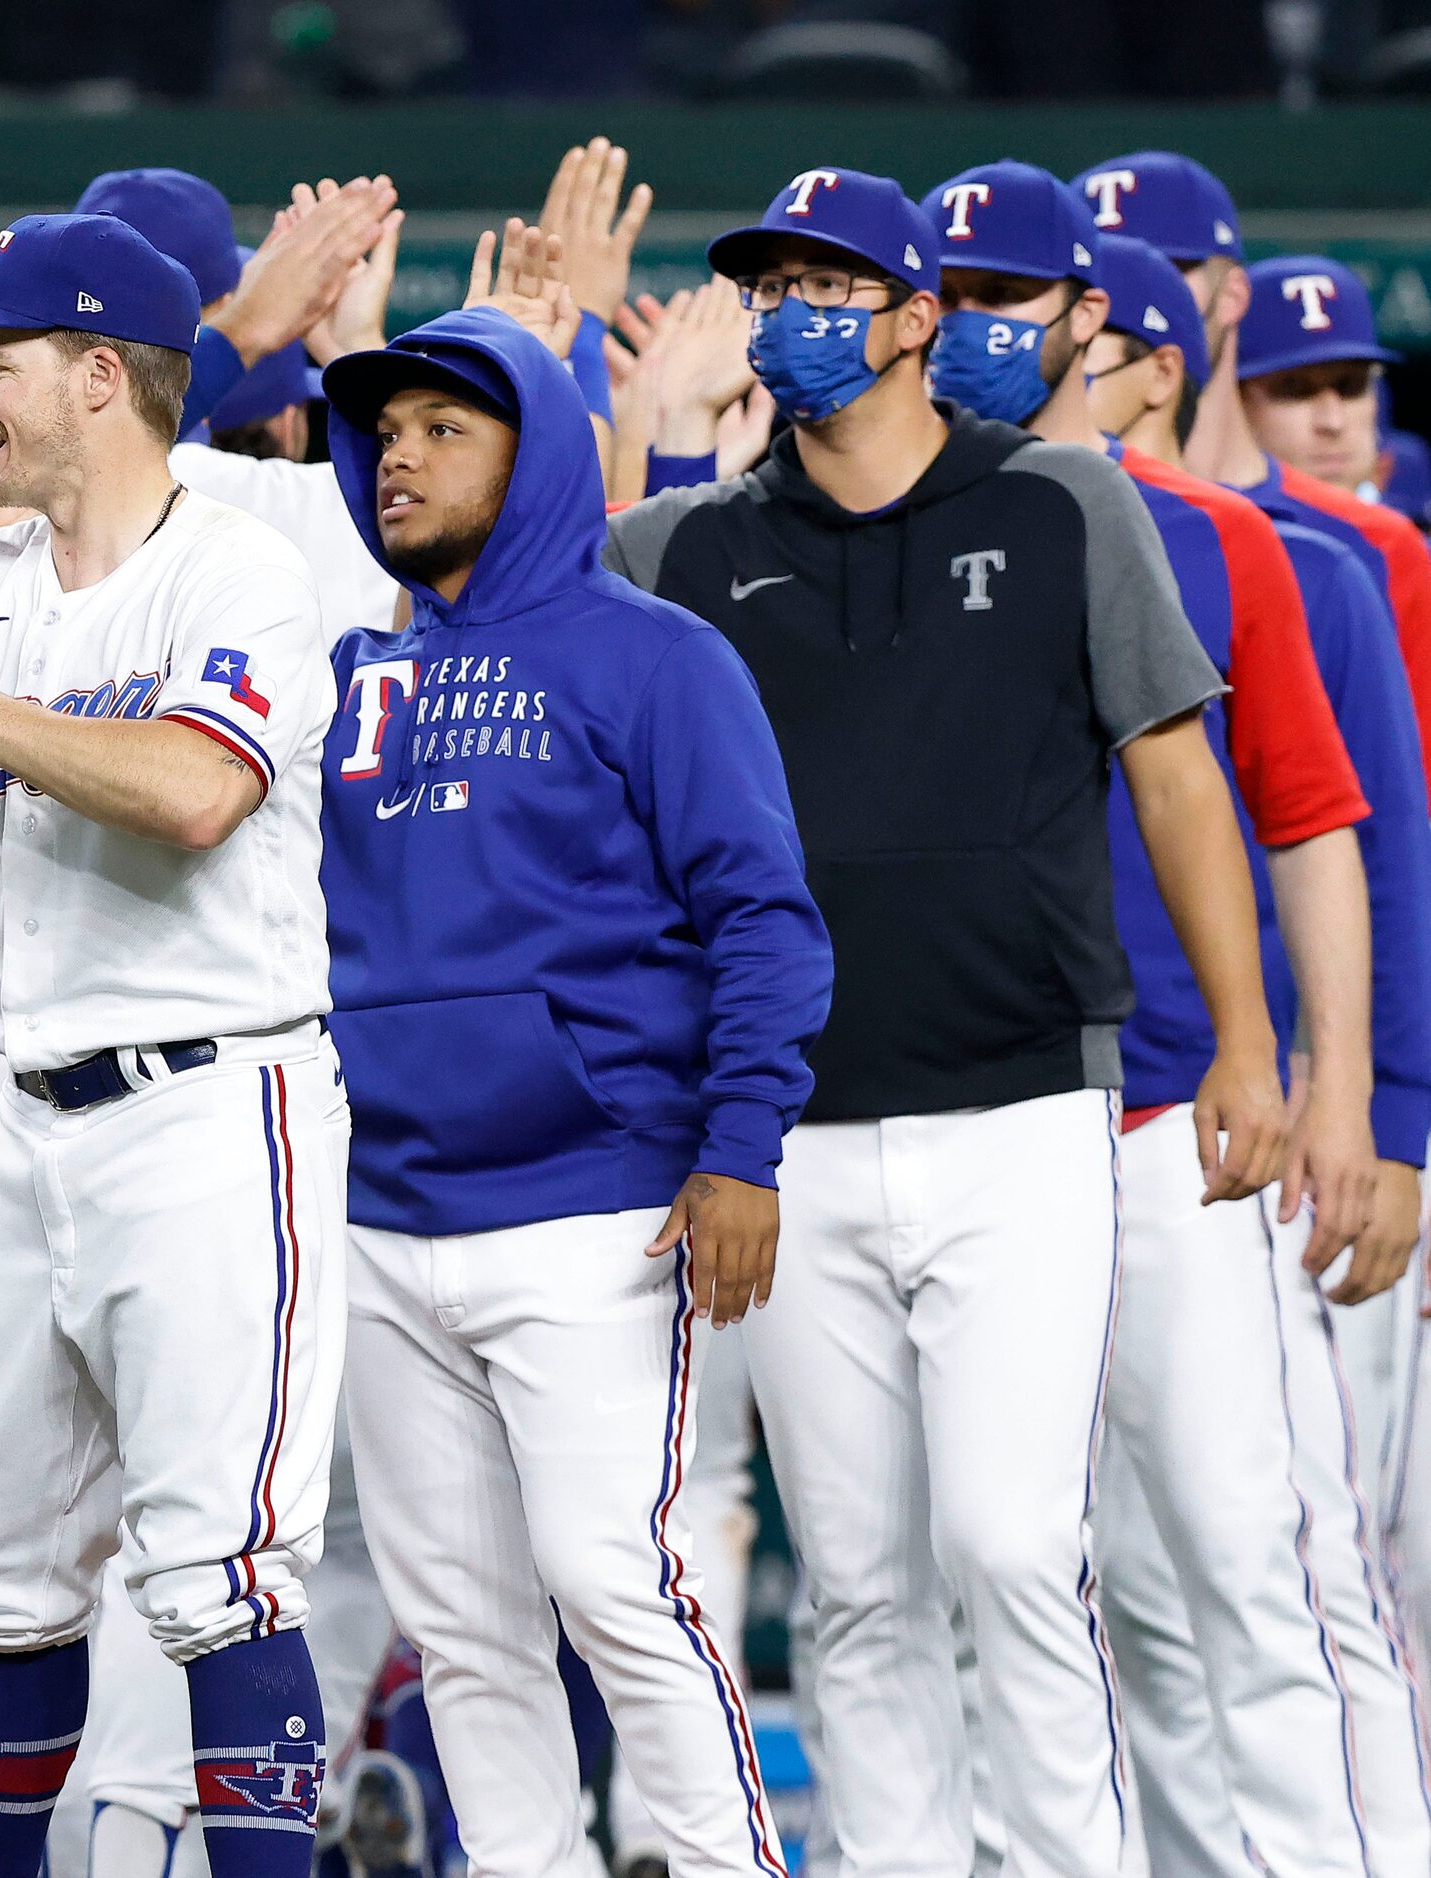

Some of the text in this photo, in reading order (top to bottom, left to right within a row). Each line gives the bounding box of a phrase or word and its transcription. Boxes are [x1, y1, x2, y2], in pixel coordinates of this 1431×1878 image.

[784, 169, 840, 217] T
[941, 183, 992, 241] T
[1084, 169, 1138, 231] T
[1281, 274, 1338, 332] T
[950, 549, 1006, 611] T
[424, 656, 512, 687] TEXAS
[340, 659, 421, 781] T
[416, 691, 546, 726] RANGERS
[412, 726, 552, 766] BASEBALL
